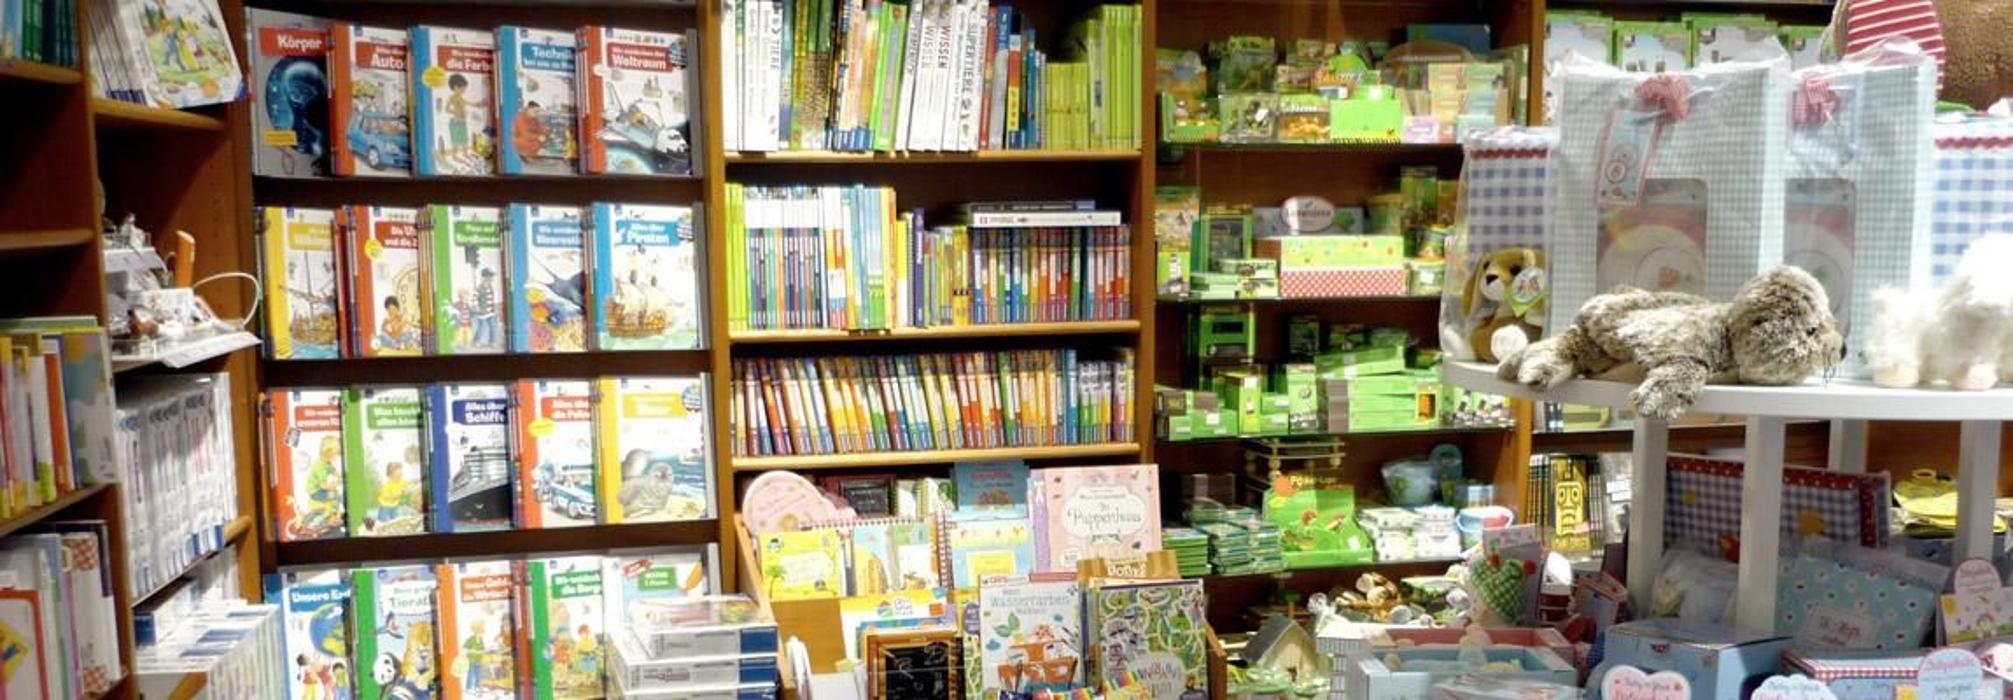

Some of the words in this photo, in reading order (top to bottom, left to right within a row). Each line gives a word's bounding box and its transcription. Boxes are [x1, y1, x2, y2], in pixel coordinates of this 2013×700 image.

[278, 34, 322, 52] Körper
[937, 26, 952, 69] WISSEN
[612, 53, 667, 70] Weltraum
[465, 402, 485, 411] Alles
[1066, 507, 1142, 530] Puppenhaus
[291, 591, 330, 603] Unsere
